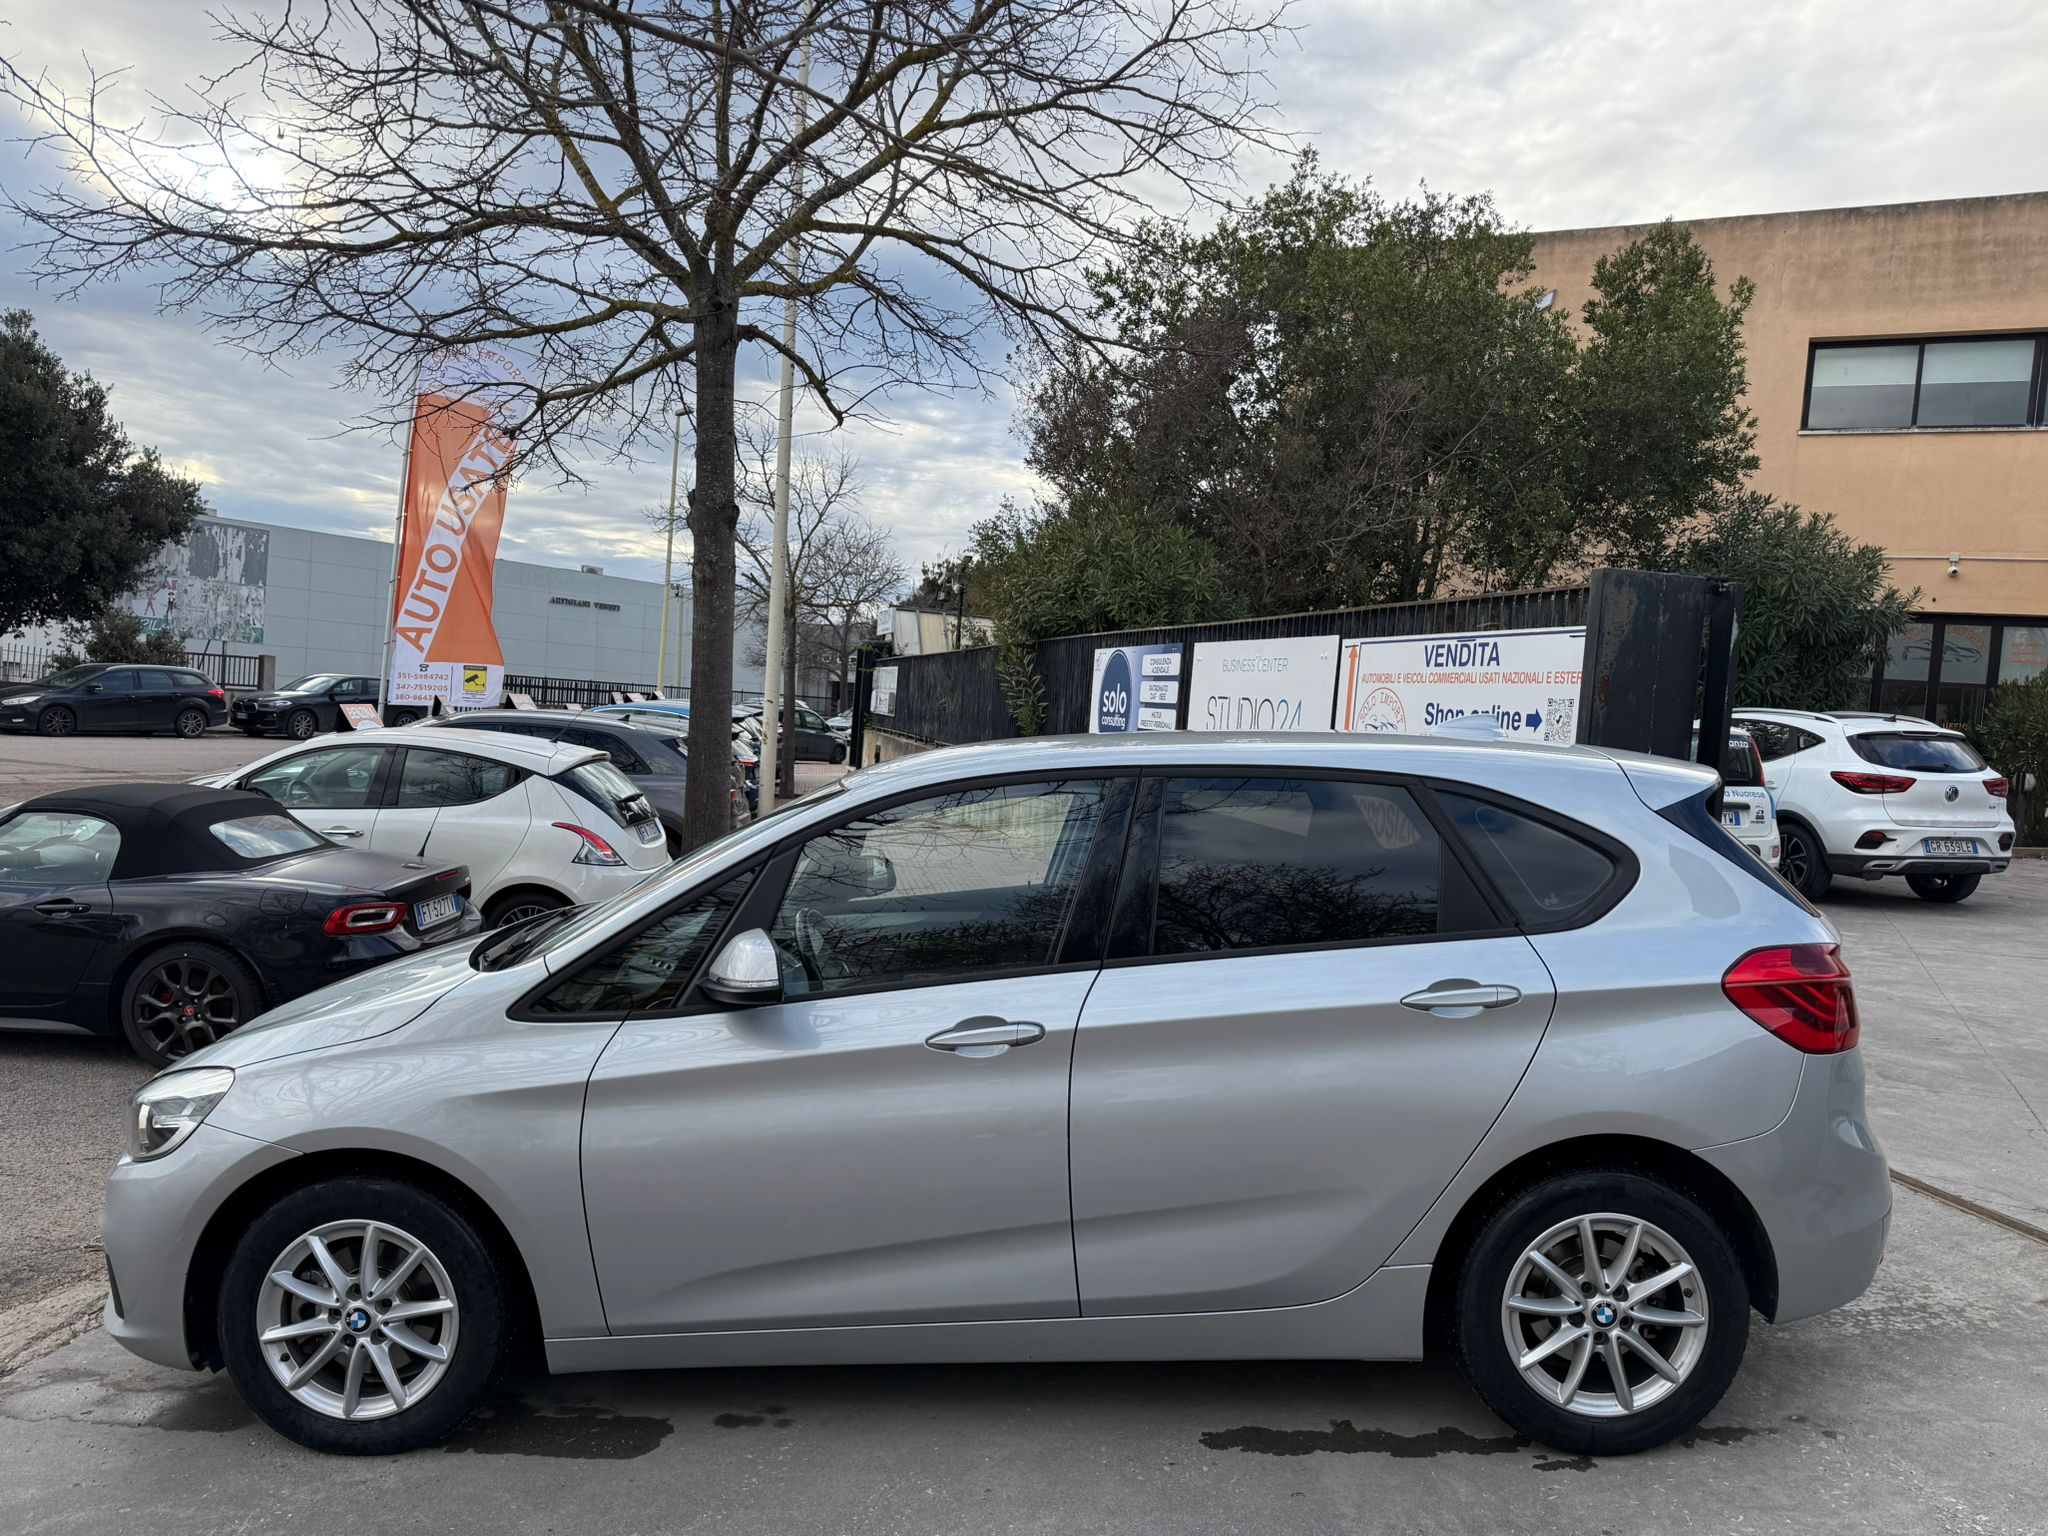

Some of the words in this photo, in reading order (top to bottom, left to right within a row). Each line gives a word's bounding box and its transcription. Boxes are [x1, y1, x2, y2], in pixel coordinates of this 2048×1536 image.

[396, 543, 459, 653] AUTO
[1222, 658, 1255, 672] BUSINESS
[1257, 657, 1289, 672] CENTER
[1424, 642, 1500, 668] VENDITA
[1361, 672, 1396, 684] AUTOMOBILI
[1396, 672, 1402, 684] E
[1402, 671, 1427, 684] VEICOLI
[1428, 671, 1477, 684] COMMERCIALI
[1478, 671, 1500, 685] USATI
[1501, 671, 1545, 685] NAZIONALI
[1546, 671, 1551, 684] E
[395, 693, 436, 701] 380-8643
[1102, 683, 1127, 714] solo
[1379, 692, 1404, 725] IMPORT
[1101, 715, 1126, 730] consulting
[1206, 695, 1302, 730] STUDIO24
[1470, 704, 1522, 731] line
[1731, 789, 1766, 798] Nuorese
